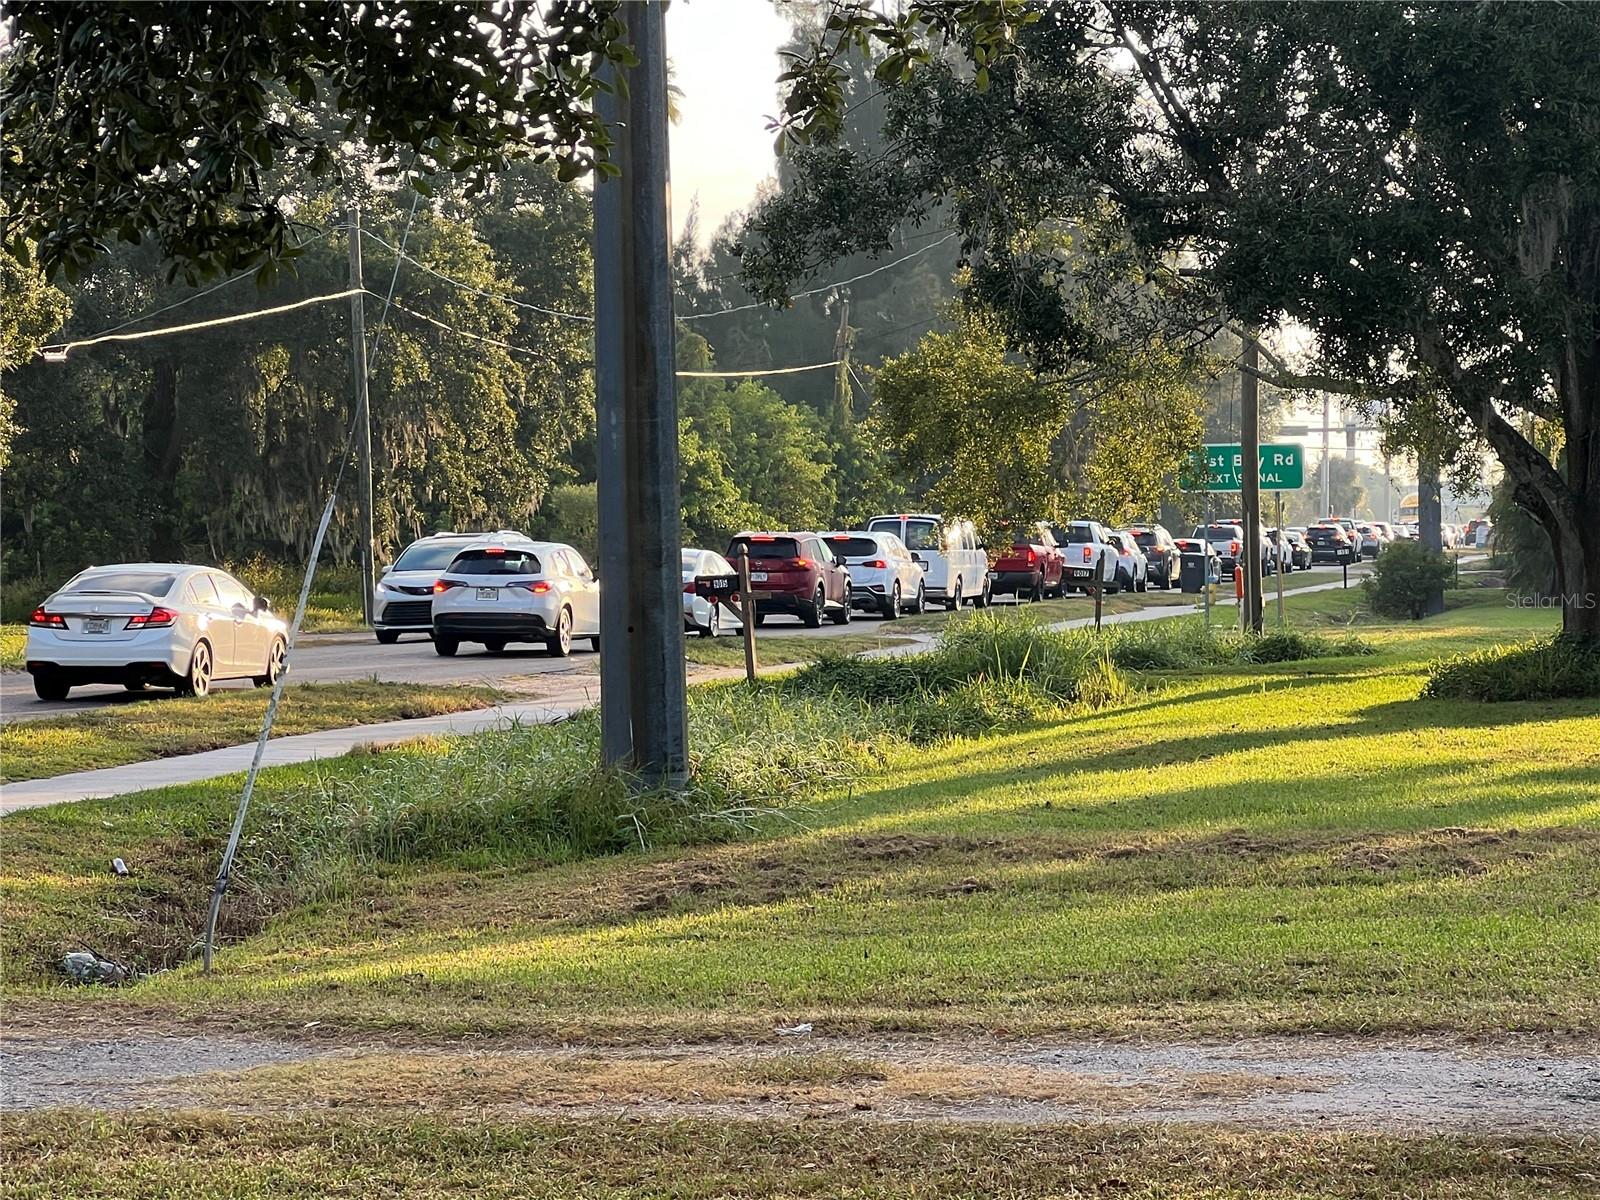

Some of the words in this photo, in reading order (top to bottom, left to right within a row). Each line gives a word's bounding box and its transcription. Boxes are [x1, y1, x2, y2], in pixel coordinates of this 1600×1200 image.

[1188, 454, 1224, 467] Est
[1234, 454, 1264, 468] By
[1274, 453, 1294, 466] Rd
[1237, 473, 1282, 483] SNAL
